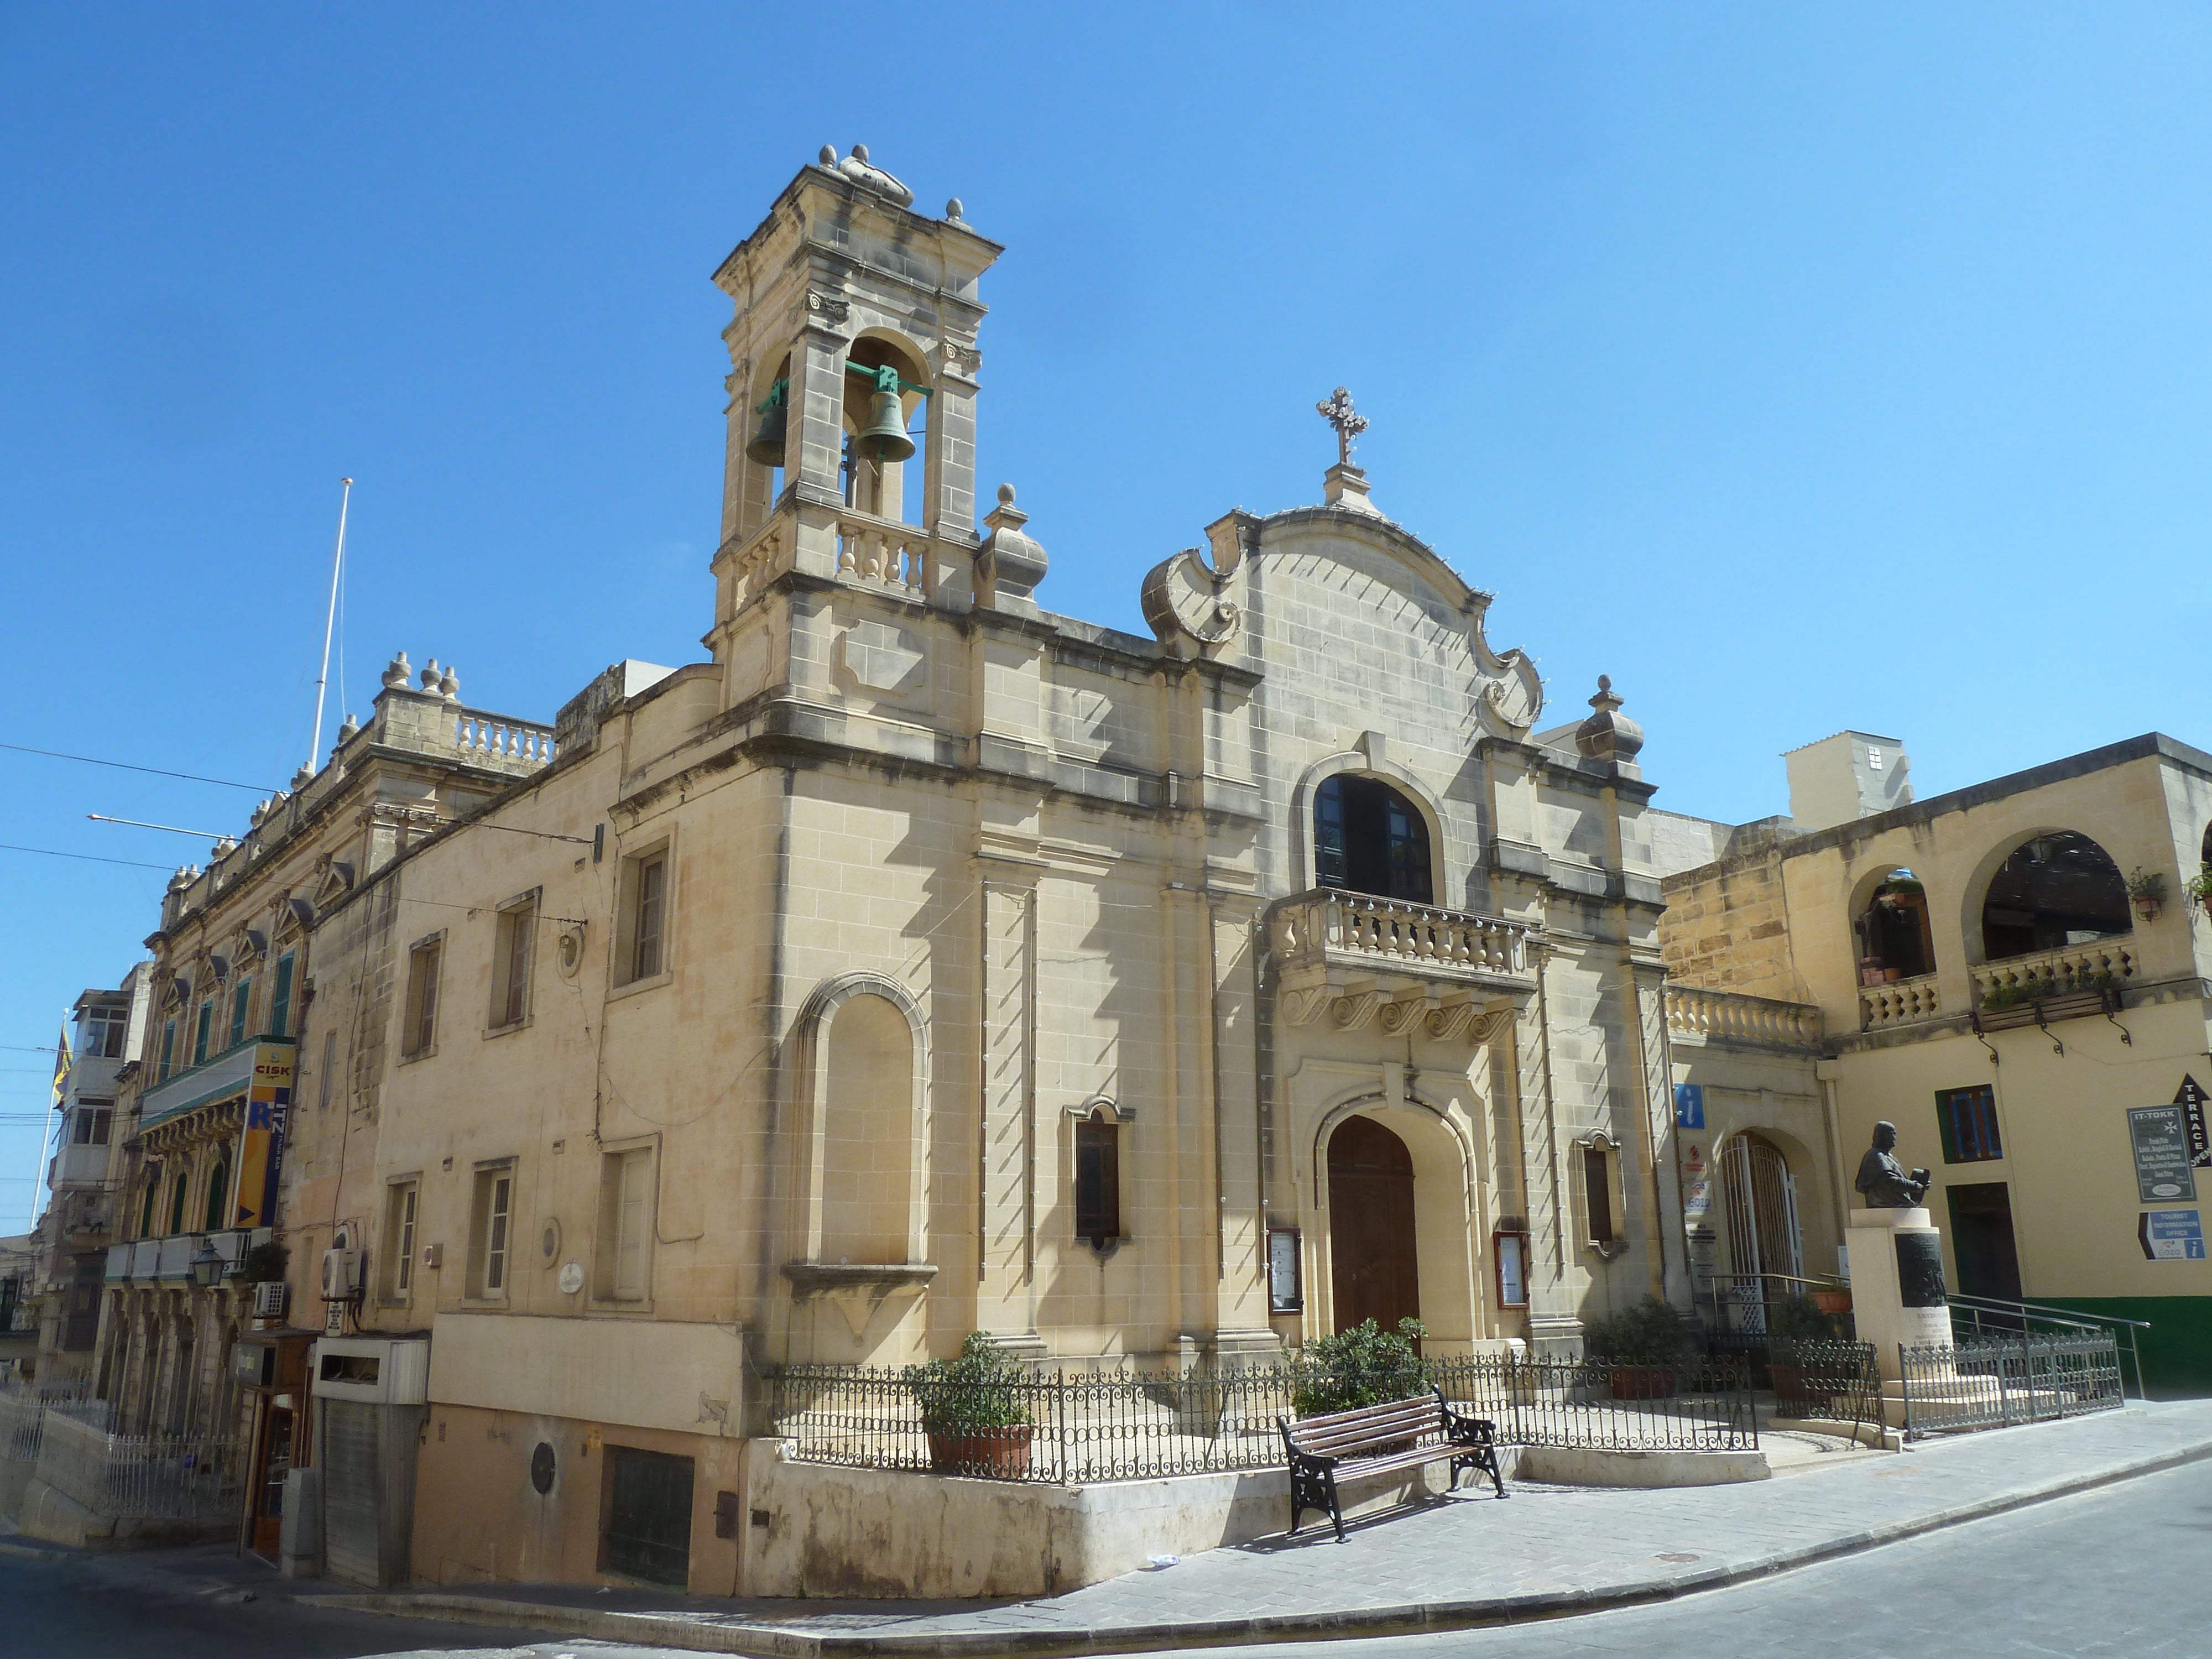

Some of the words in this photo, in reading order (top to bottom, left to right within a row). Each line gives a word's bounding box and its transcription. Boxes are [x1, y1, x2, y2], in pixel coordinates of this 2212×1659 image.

[255, 1065, 290, 1076] CISK
[2135, 1110, 2175, 1120] IT-TOKK
[2184, 1084, 2204, 1150] TERRACE
[2191, 1147, 2211, 1167] OPEN
[1689, 1197, 1710, 1207] GOZO
